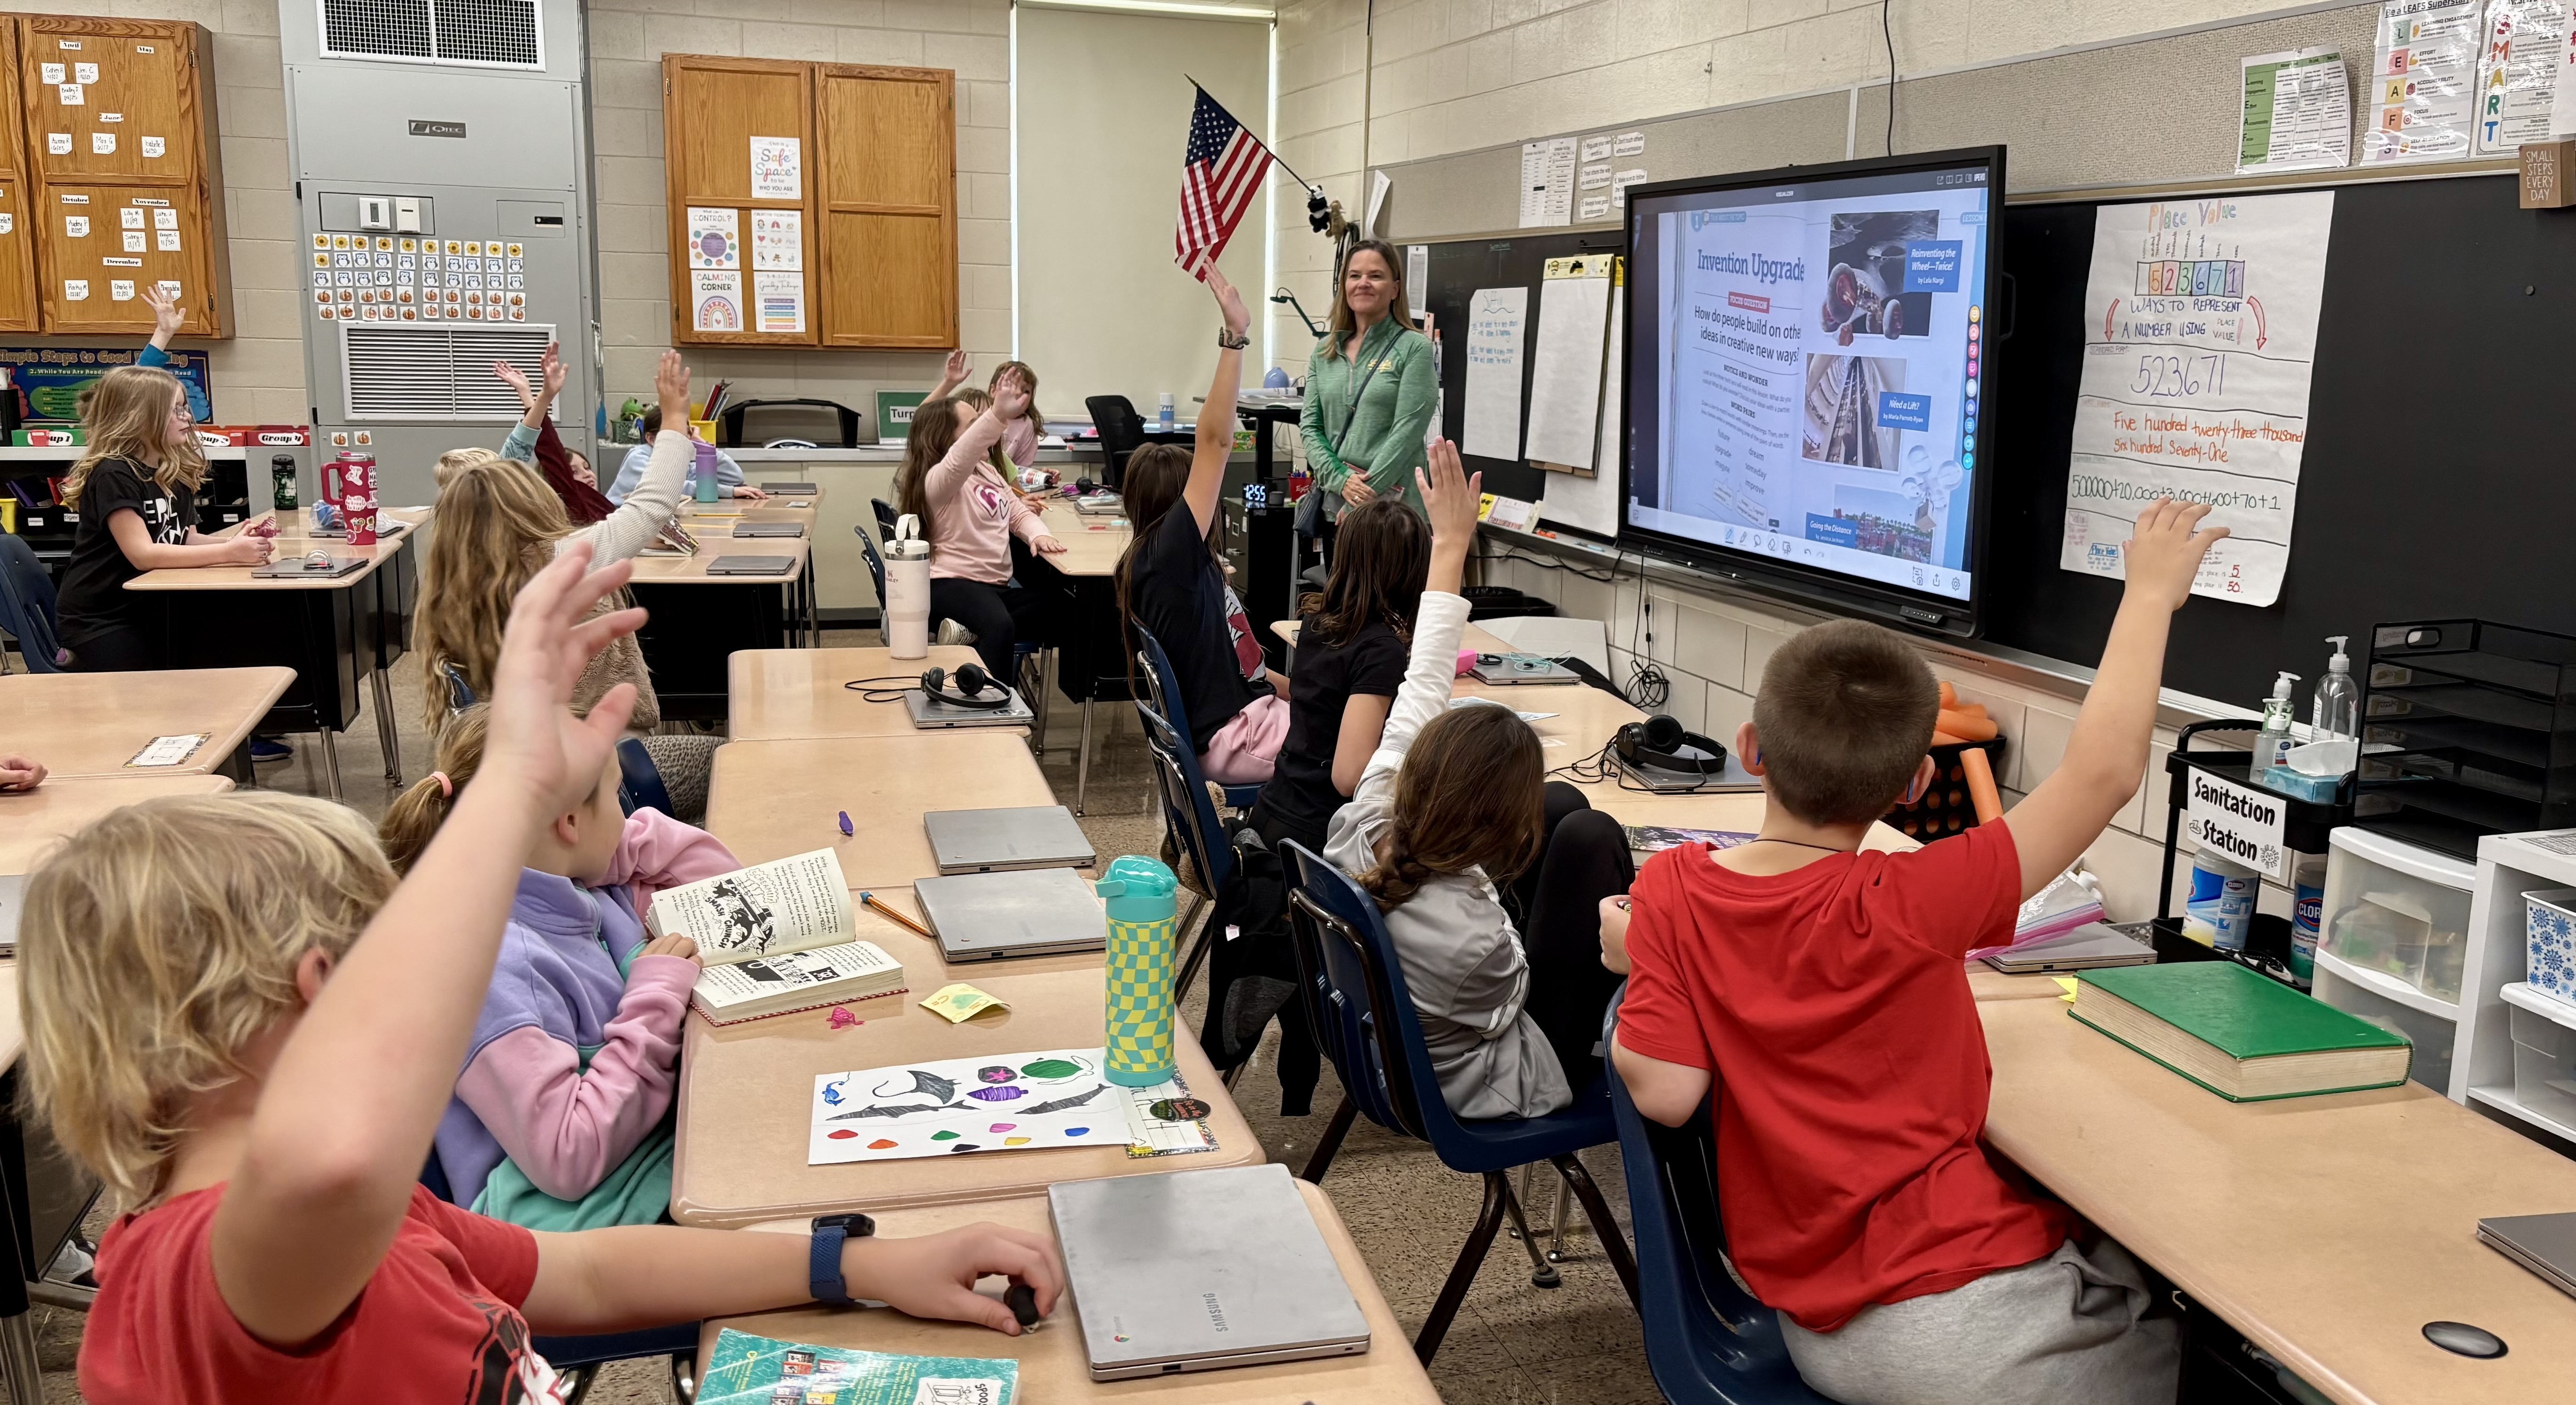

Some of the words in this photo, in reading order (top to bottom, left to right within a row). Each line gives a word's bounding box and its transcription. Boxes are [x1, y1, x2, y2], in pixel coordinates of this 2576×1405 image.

[2385, 8, 2396, 17] Be
[2403, 2, 2426, 13] LEAFS
[2398, 28, 2404, 39] L
[2491, 40, 2509, 62] M
[2395, 56, 2402, 68] E
[2489, 69, 2503, 88] A
[2391, 86, 2398, 97] A
[2487, 94, 2500, 116] R
[2389, 115, 2396, 125] F
[2484, 121, 2498, 142] T
[761, 148, 791, 167] Safe
[2526, 150, 2554, 163] SMALL
[755, 162, 793, 182] Space
[2528, 164, 2553, 176] STEPS
[2526, 176, 2554, 188] EVERY
[2530, 189, 2550, 202] DAY
[2148, 203, 2187, 234] Place
[2198, 200, 2236, 227] Value
[1911, 249, 1945, 260] Reinventing
[1945, 248, 1956, 258] the
[1697, 249, 1749, 275] Invention
[1751, 253, 1805, 284] Upgrade
[2151, 270, 2160, 291] 5
[2164, 268, 2174, 291] 2
[2195, 267, 2205, 290] 6
[2212, 269, 2222, 292] 7
[2228, 267, 2235, 293] 1
[1730, 295, 1743, 305] FOCUS
[1743, 298, 1768, 310] QUESTION
[2131, 298, 2165, 313] WAYS
[2169, 300, 2185, 312] TO
[2193, 298, 2242, 313] REPRESENT
[1695, 305, 1711, 319] How
[1712, 308, 1720, 323] do
[1722, 314, 1745, 331] people
[1747, 316, 1767, 336] build
[1769, 326, 1781, 338] on
[2122, 322, 2130, 339] A
[2135, 322, 2171, 337] NUMBER
[2179, 322, 2205, 337] USING
[2217, 318, 2235, 328] PLACE
[1700, 326, 1719, 343] ideas
[1720, 331, 1726, 345] in
[1727, 335, 1755, 355] creative
[1756, 345, 1774, 359] new
[0, 350, 39, 366] imple
[41, 350, 78, 366] Steps
[80, 351, 95, 363] to
[97, 351, 132, 363] Good
[1724, 364, 1738, 375] NOTICE
[1739, 370, 1748, 380] AND
[1748, 374, 1768, 387] WONDER
[2131, 353, 2226, 397] 523,671
[1731, 401, 1743, 412] WORD
[1743, 406, 1755, 418] PAIRS
[1889, 400, 1904, 409] Need
[1907, 401, 1920, 410] Lift?
[2113, 411, 2137, 431] Five
[2144, 413, 2187, 431] hundred
[2191, 418, 2257, 447] twenty-three
[2260, 420, 2304, 444] thousand
[262, 435, 292, 443] Group
[2130, 435, 2163, 454] hundred
[1748, 447, 1764, 461] dream
[1745, 479, 1765, 495] improve
[1810, 520, 1823, 532] Going
[1832, 524, 1852, 535] Distance
[2092, 544, 2104, 556] Place
[2195, 776, 2275, 827] Sanitation
[2202, 819, 2257, 861] Station
[705, 897, 725, 917] SMASH
[2299, 903, 2322, 919] CLOR
[718, 920, 732, 949] CRUNCH
[1202, 1293, 1229, 1332] SAMSUNG
[974, 1383, 988, 1405] SPOO
